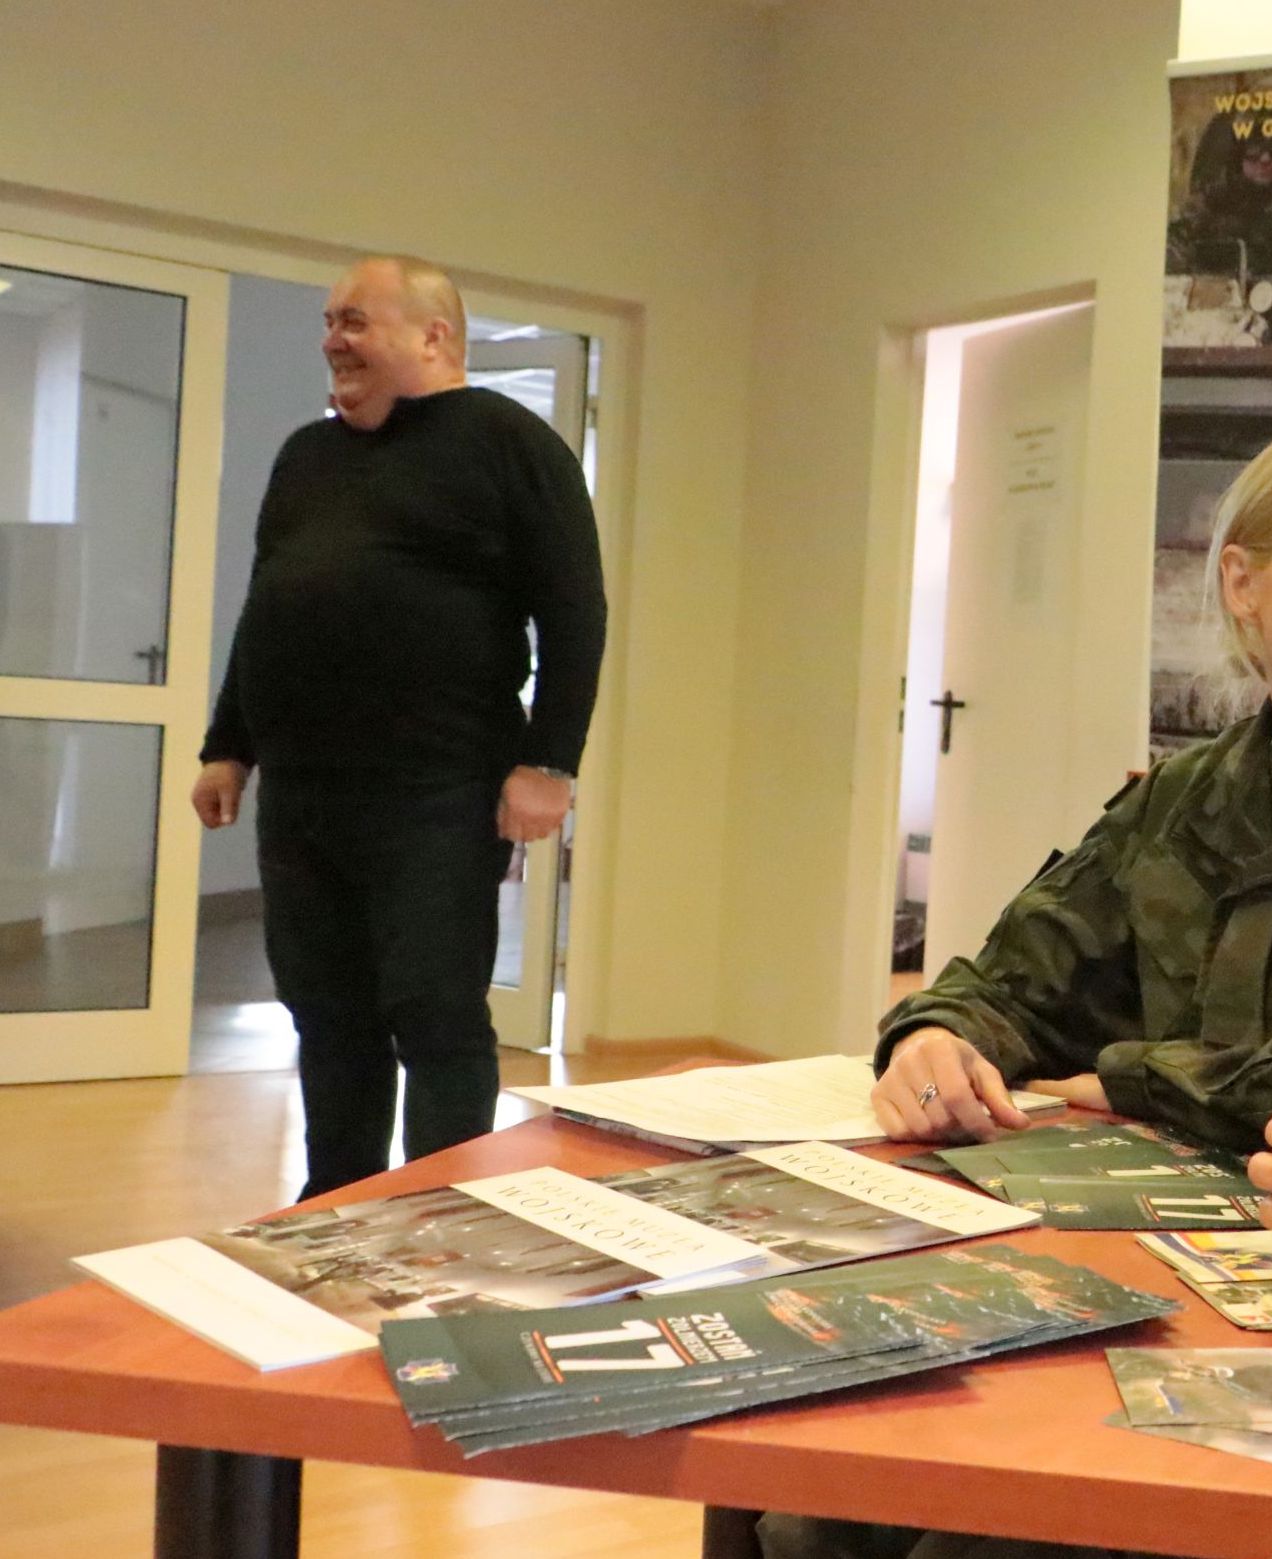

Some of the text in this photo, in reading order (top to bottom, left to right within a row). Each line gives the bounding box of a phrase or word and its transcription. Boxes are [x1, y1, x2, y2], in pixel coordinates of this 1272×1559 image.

[1232, 119, 1254, 140] W
[780, 1153, 957, 1220] WOJSKOWE
[496, 1185, 676, 1260] WOJSKOWE
[544, 1319, 687, 1371] 17
